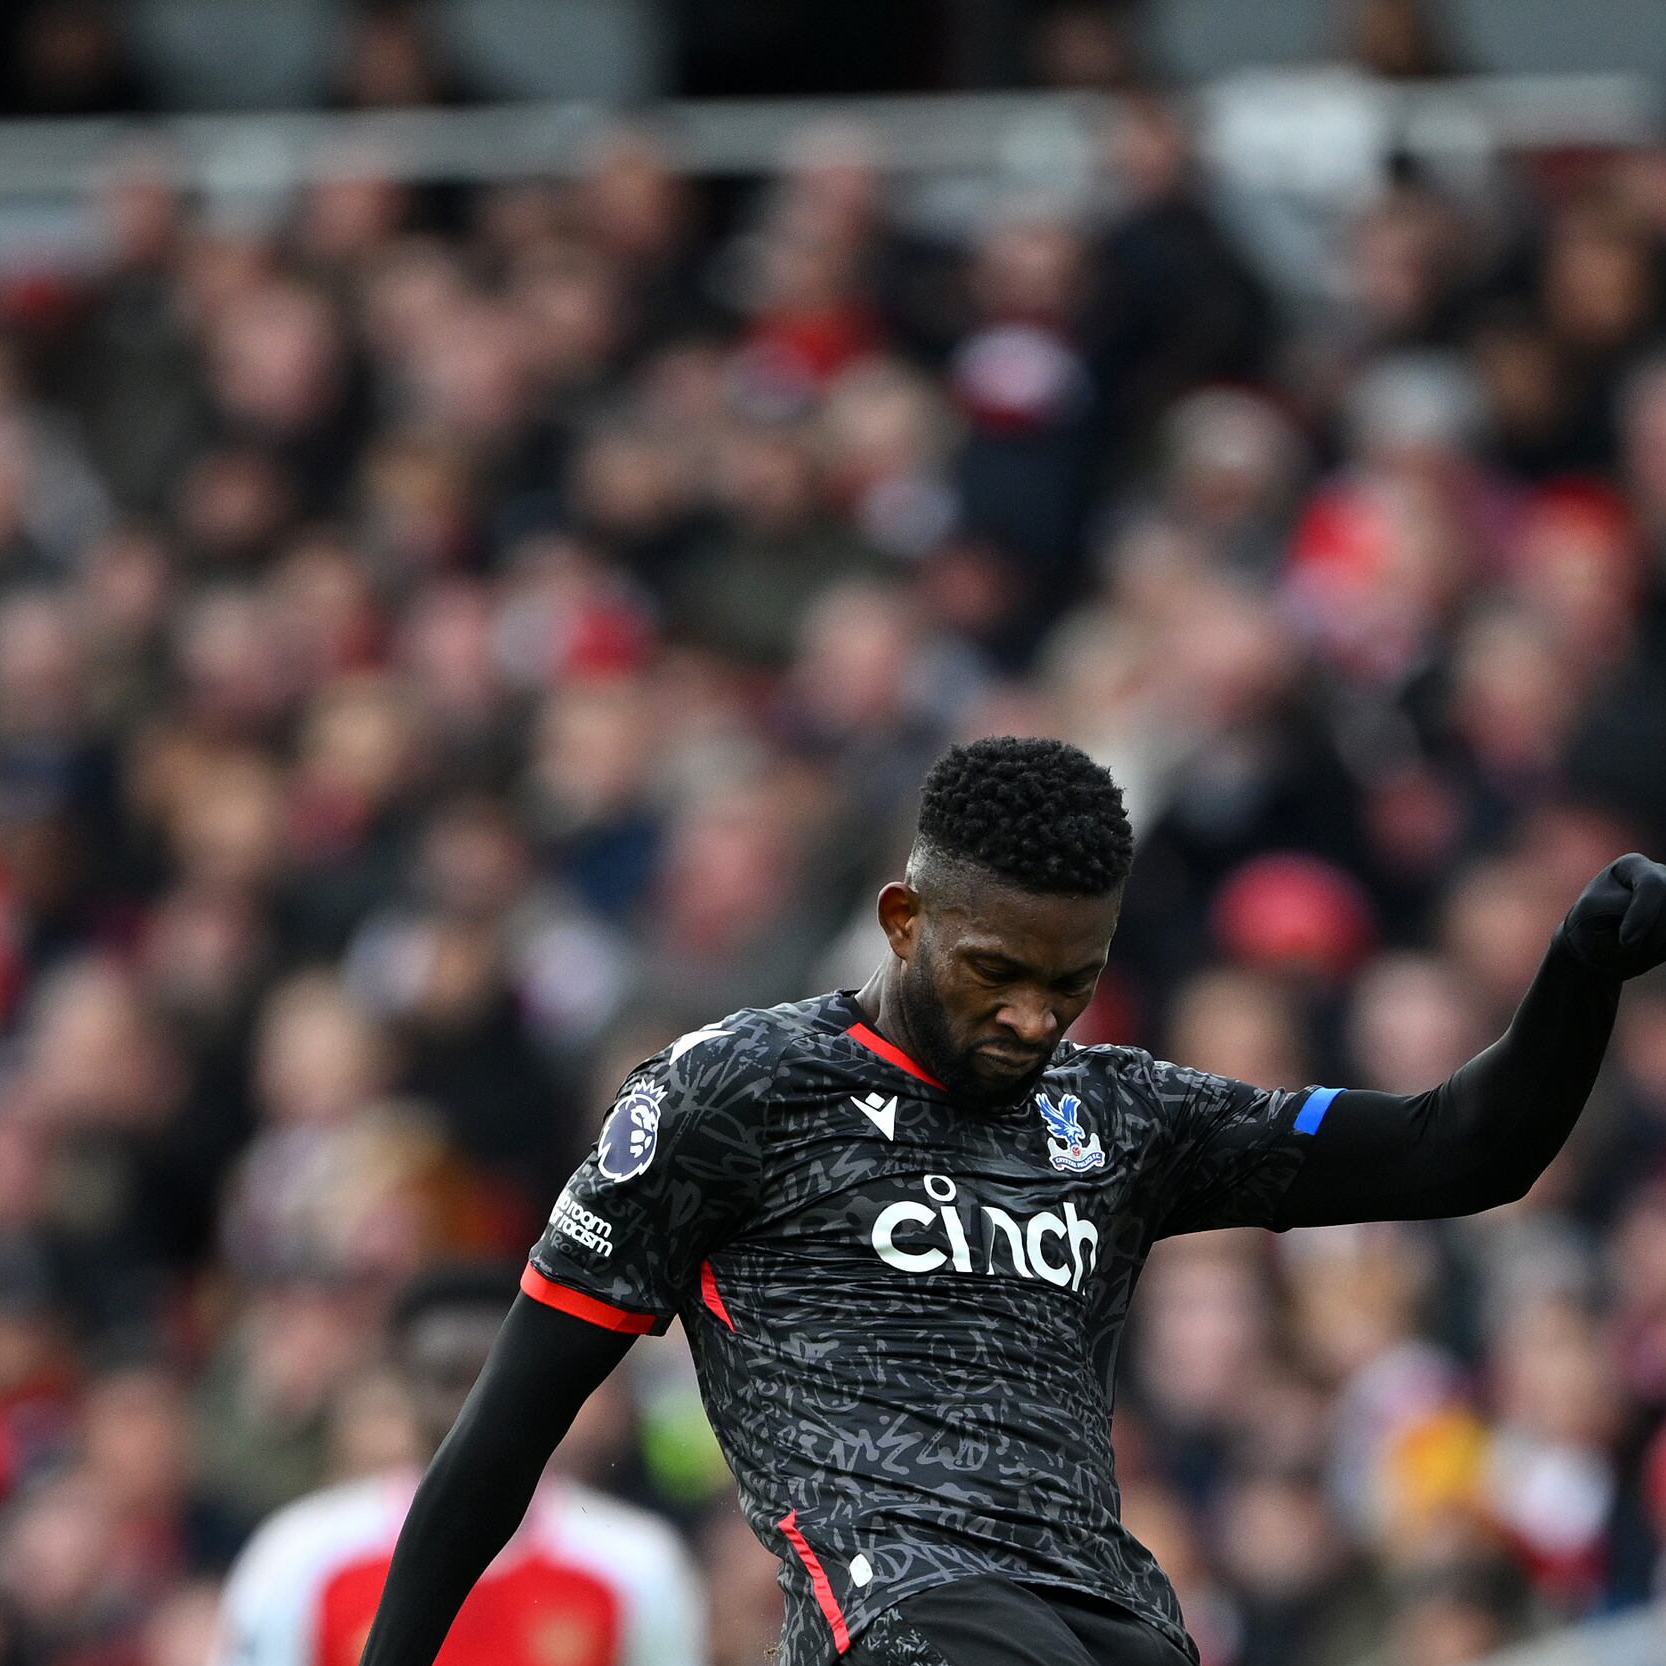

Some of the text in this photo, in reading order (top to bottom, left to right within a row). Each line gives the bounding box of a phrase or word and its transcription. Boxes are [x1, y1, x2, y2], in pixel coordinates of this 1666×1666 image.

[557, 1214, 613, 1257] racism
[566, 1200, 612, 1238] room
[872, 1174, 1099, 1296] cinch
